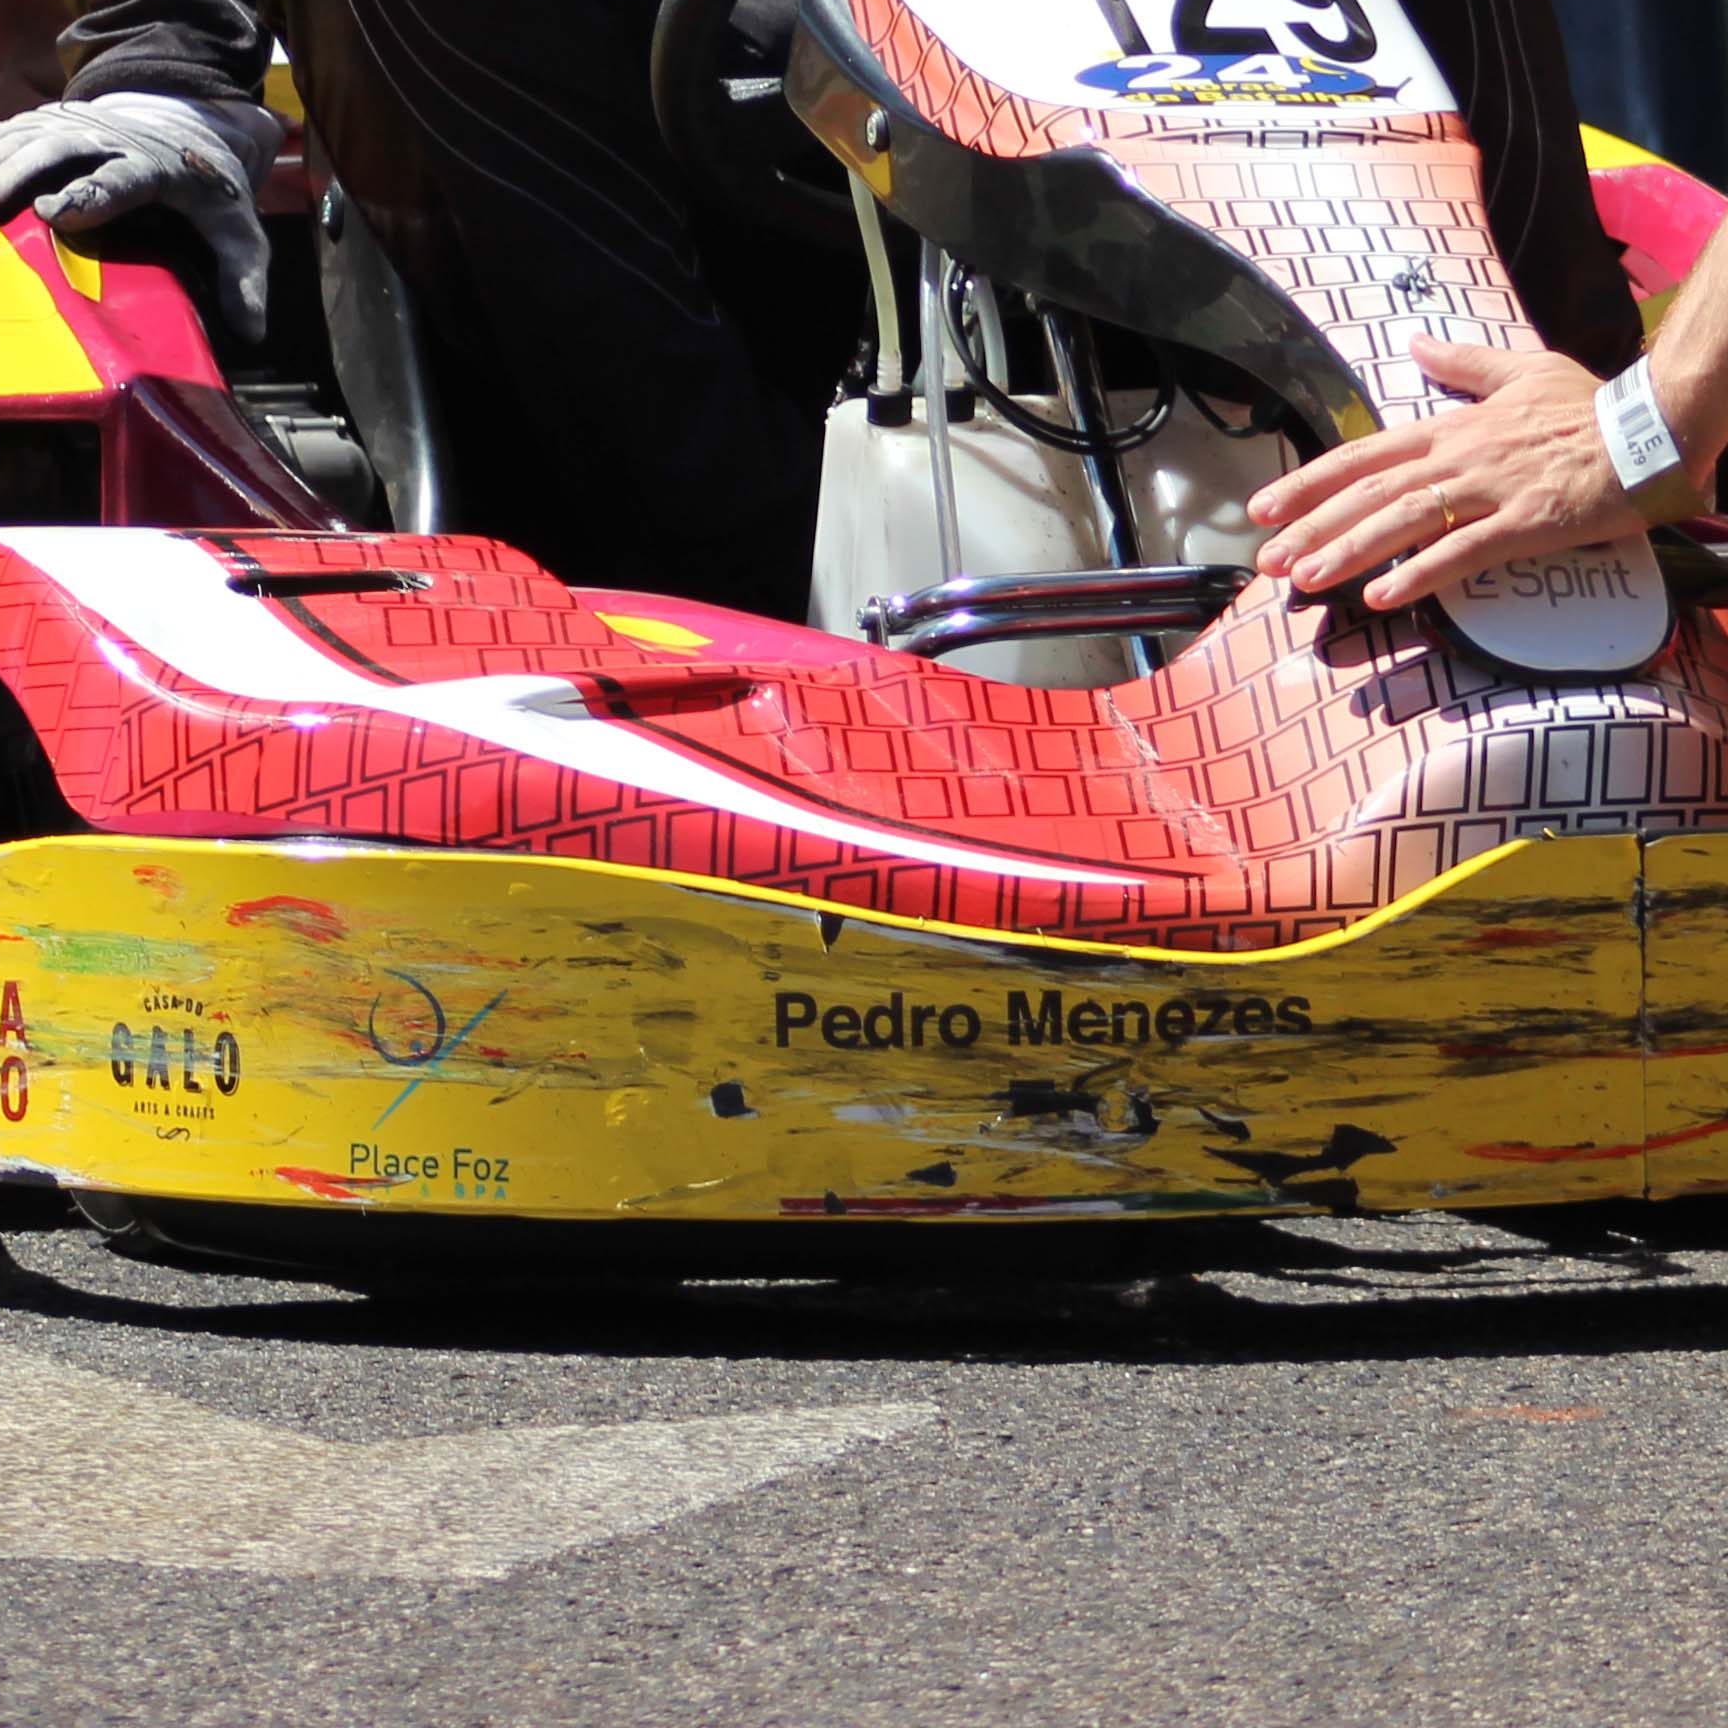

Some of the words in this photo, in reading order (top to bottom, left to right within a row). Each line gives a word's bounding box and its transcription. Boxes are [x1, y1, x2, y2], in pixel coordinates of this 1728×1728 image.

[1116, 52, 1311, 89] 24
[1171, 80, 1287, 92] horas
[1124, 91, 1182, 104] da
[1194, 90, 1376, 104] Batalha
[1504, 556, 1640, 609] Spirit
[144, 995, 180, 1013] CASA
[184, 999, 204, 1016] DO
[774, 989, 982, 1050] Pedro
[1007, 988, 1314, 1048] Menezes
[111, 1021, 241, 1097] GALO
[133, 1101, 158, 1116] ARTS
[350, 1143, 440, 1179] Place
[453, 1148, 510, 1182] Foz
